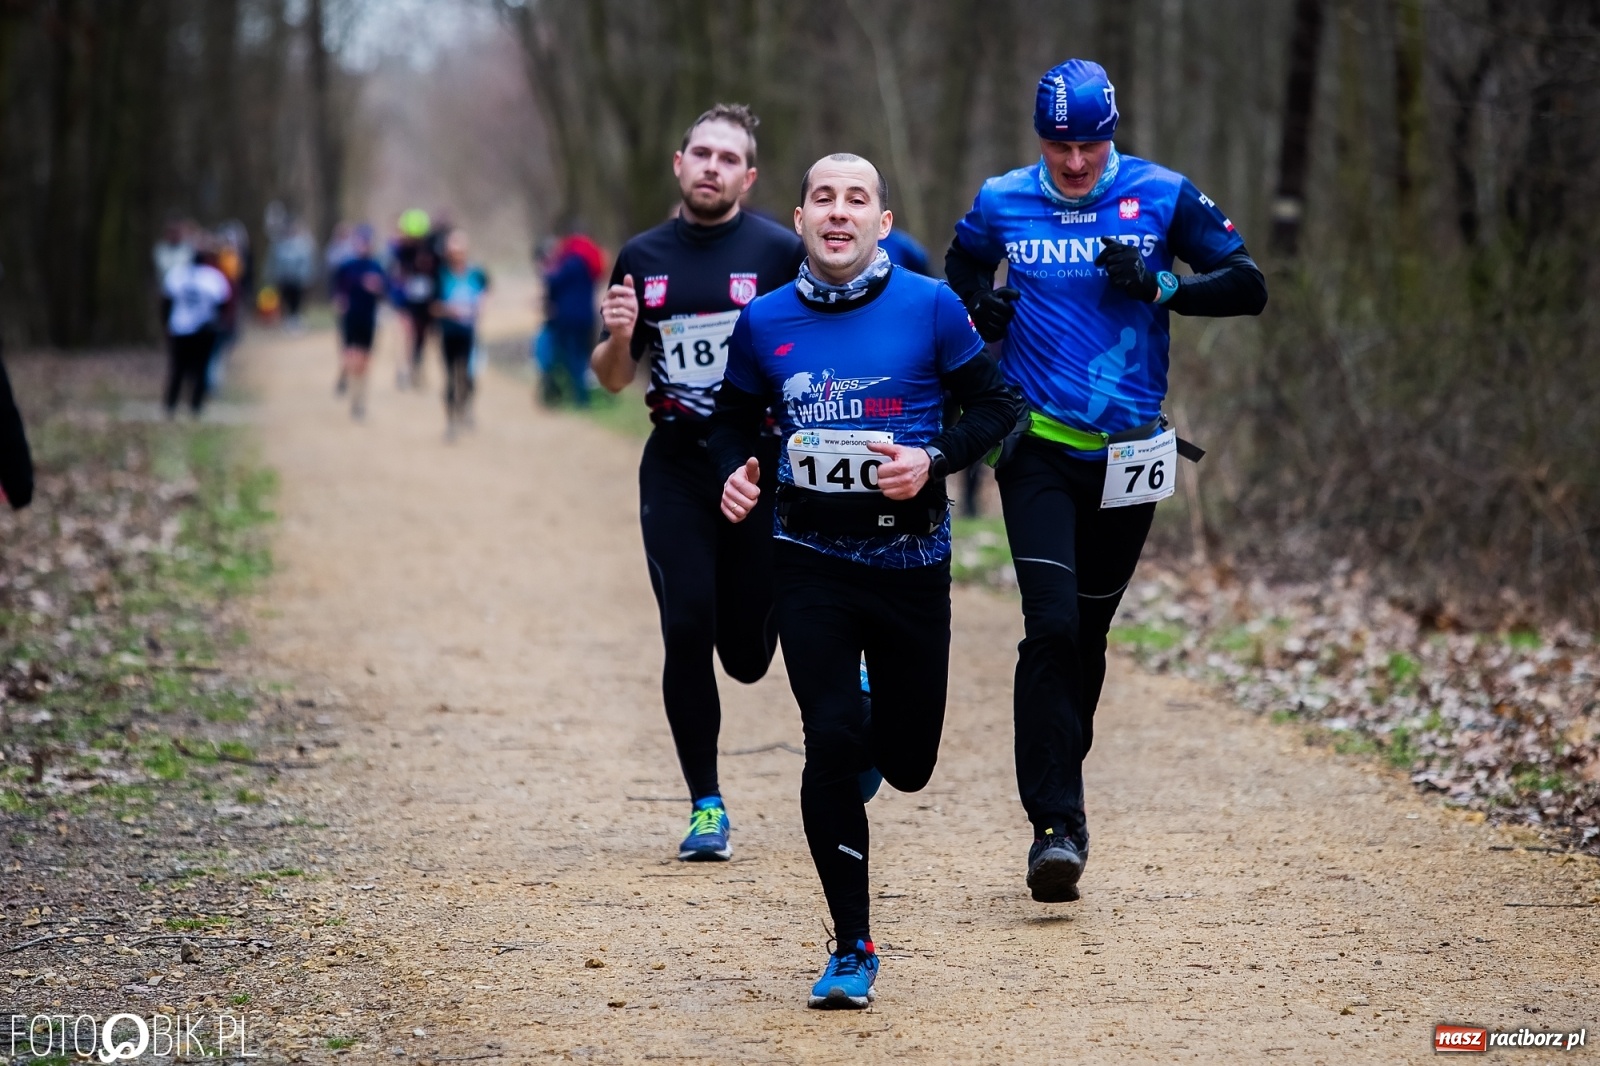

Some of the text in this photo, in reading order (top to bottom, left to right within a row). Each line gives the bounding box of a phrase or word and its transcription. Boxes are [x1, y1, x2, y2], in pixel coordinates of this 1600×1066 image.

[1054, 74, 1068, 122] RUNNERS
[1026, 269, 1093, 279] EKO-OKNA
[671, 336, 731, 370] 18
[811, 379, 859, 393] WINGS
[818, 390, 846, 402] LIFE
[798, 397, 903, 424] WORLD RUN
[798, 455, 883, 491] 140
[1124, 460, 1165, 494] 76
